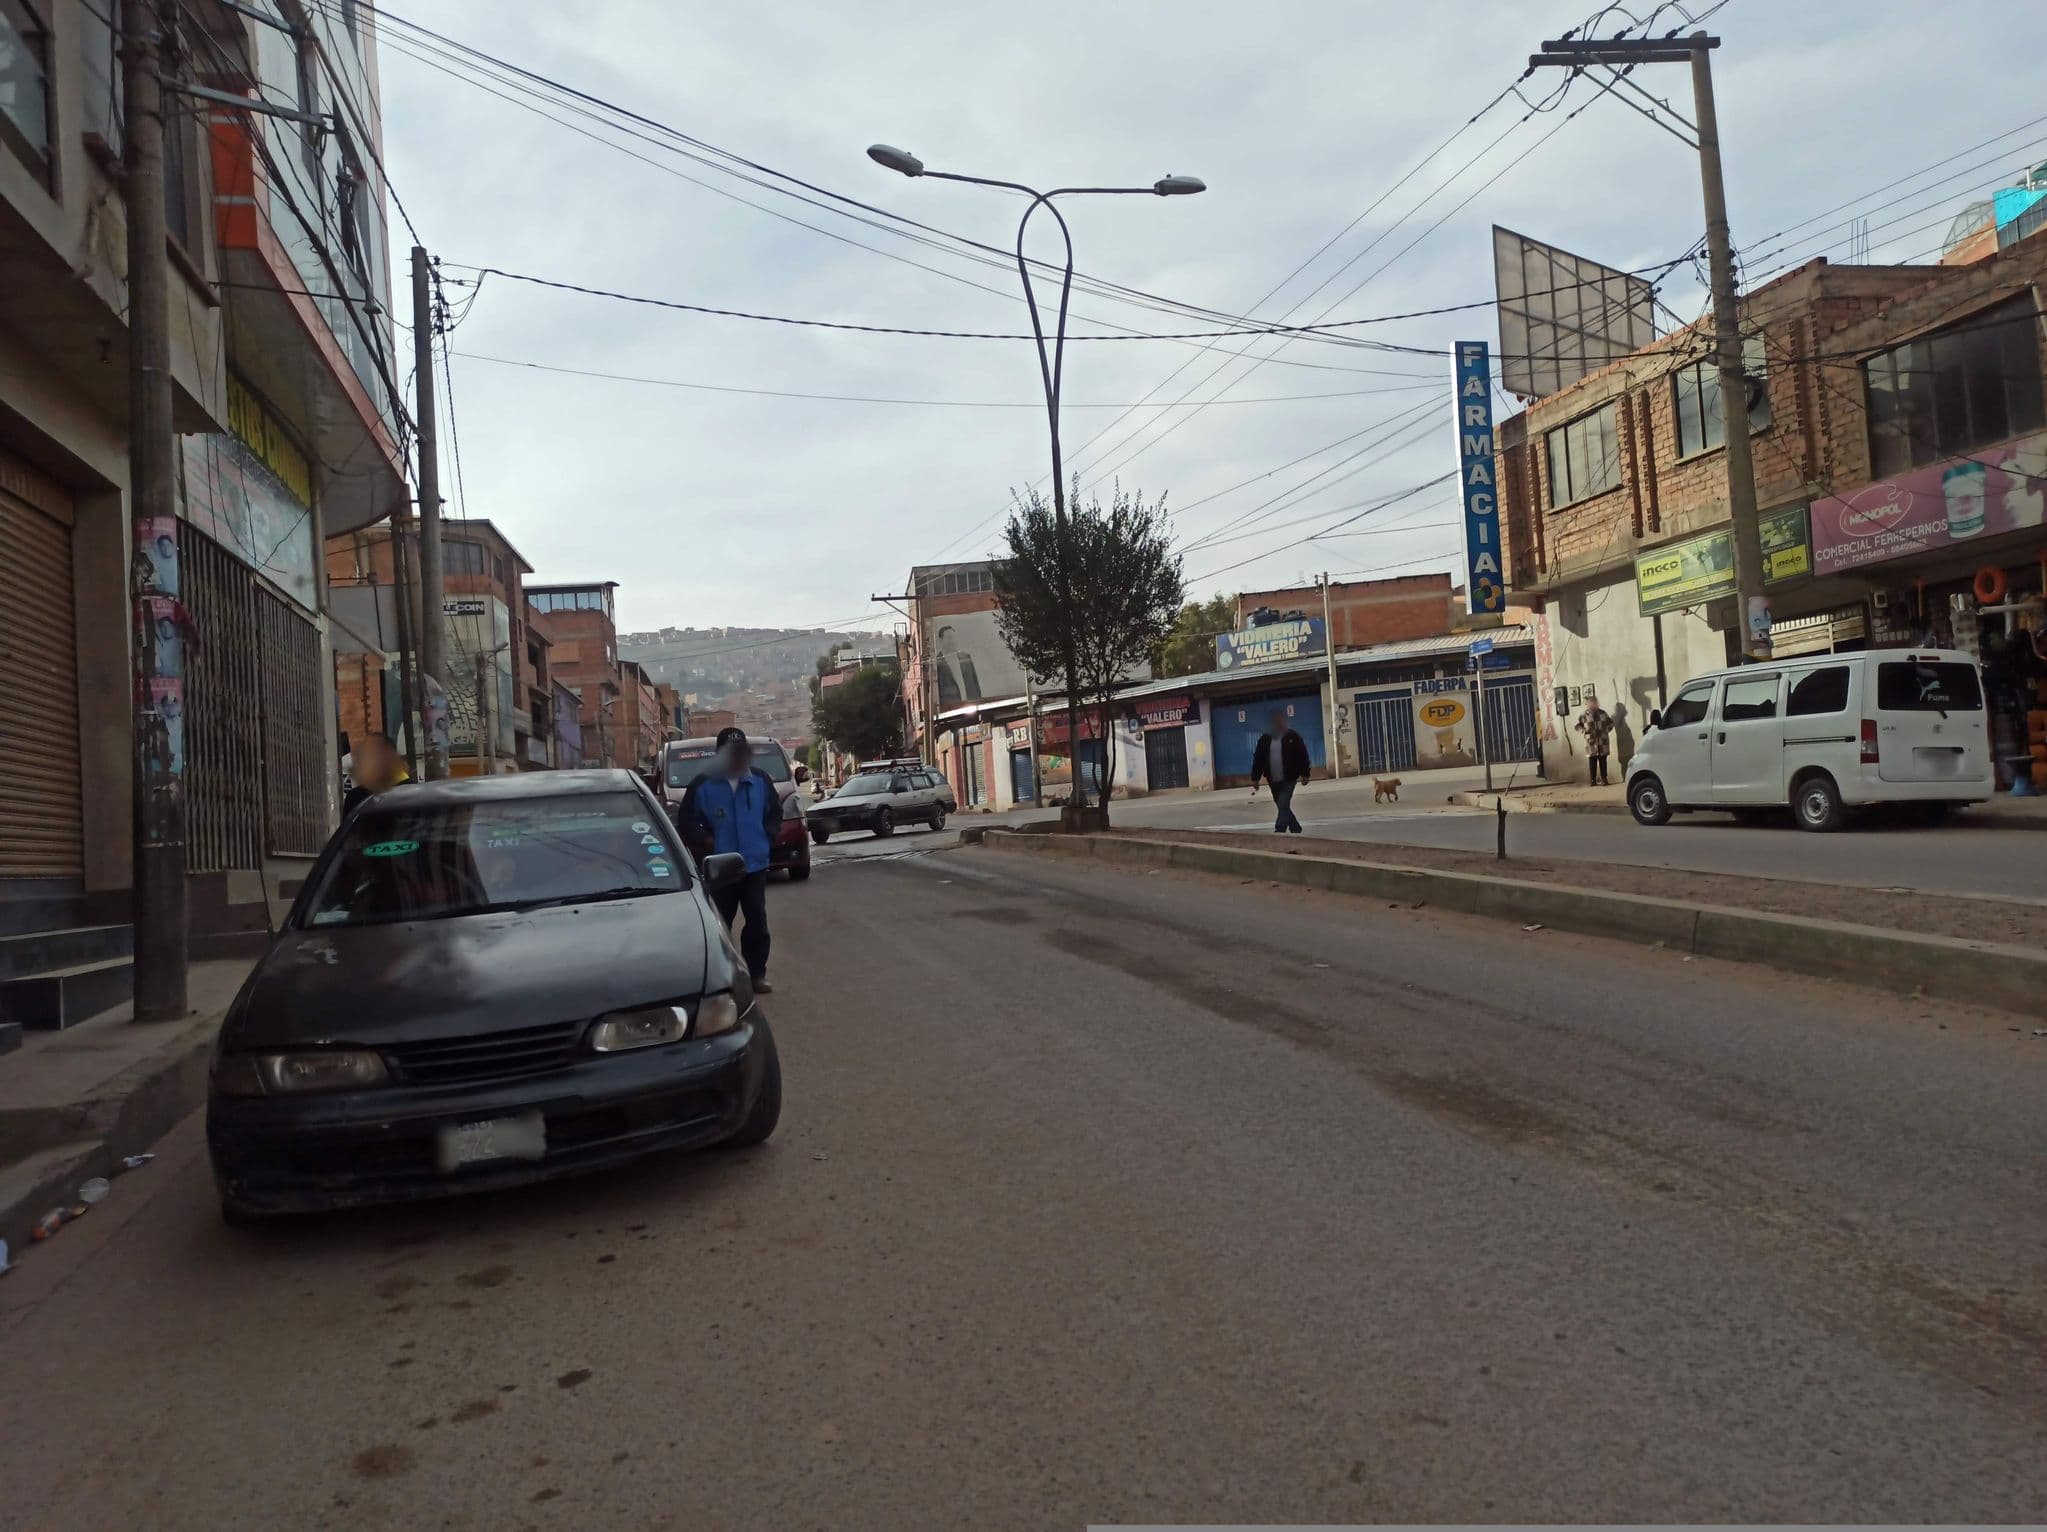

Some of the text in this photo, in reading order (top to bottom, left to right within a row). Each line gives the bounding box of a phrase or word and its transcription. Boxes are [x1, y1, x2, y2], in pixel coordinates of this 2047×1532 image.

[1462, 346, 1498, 574] FARMACIA
[1850, 502, 1902, 526] MONOPOL
[1815, 538, 1872, 562] COMERCIAL
[1413, 676, 1467, 695] FADERPA
[1536, 612, 1558, 741] ARMACIA
[370, 843, 414, 854] TAXI
[487, 838, 520, 848] TAXI
